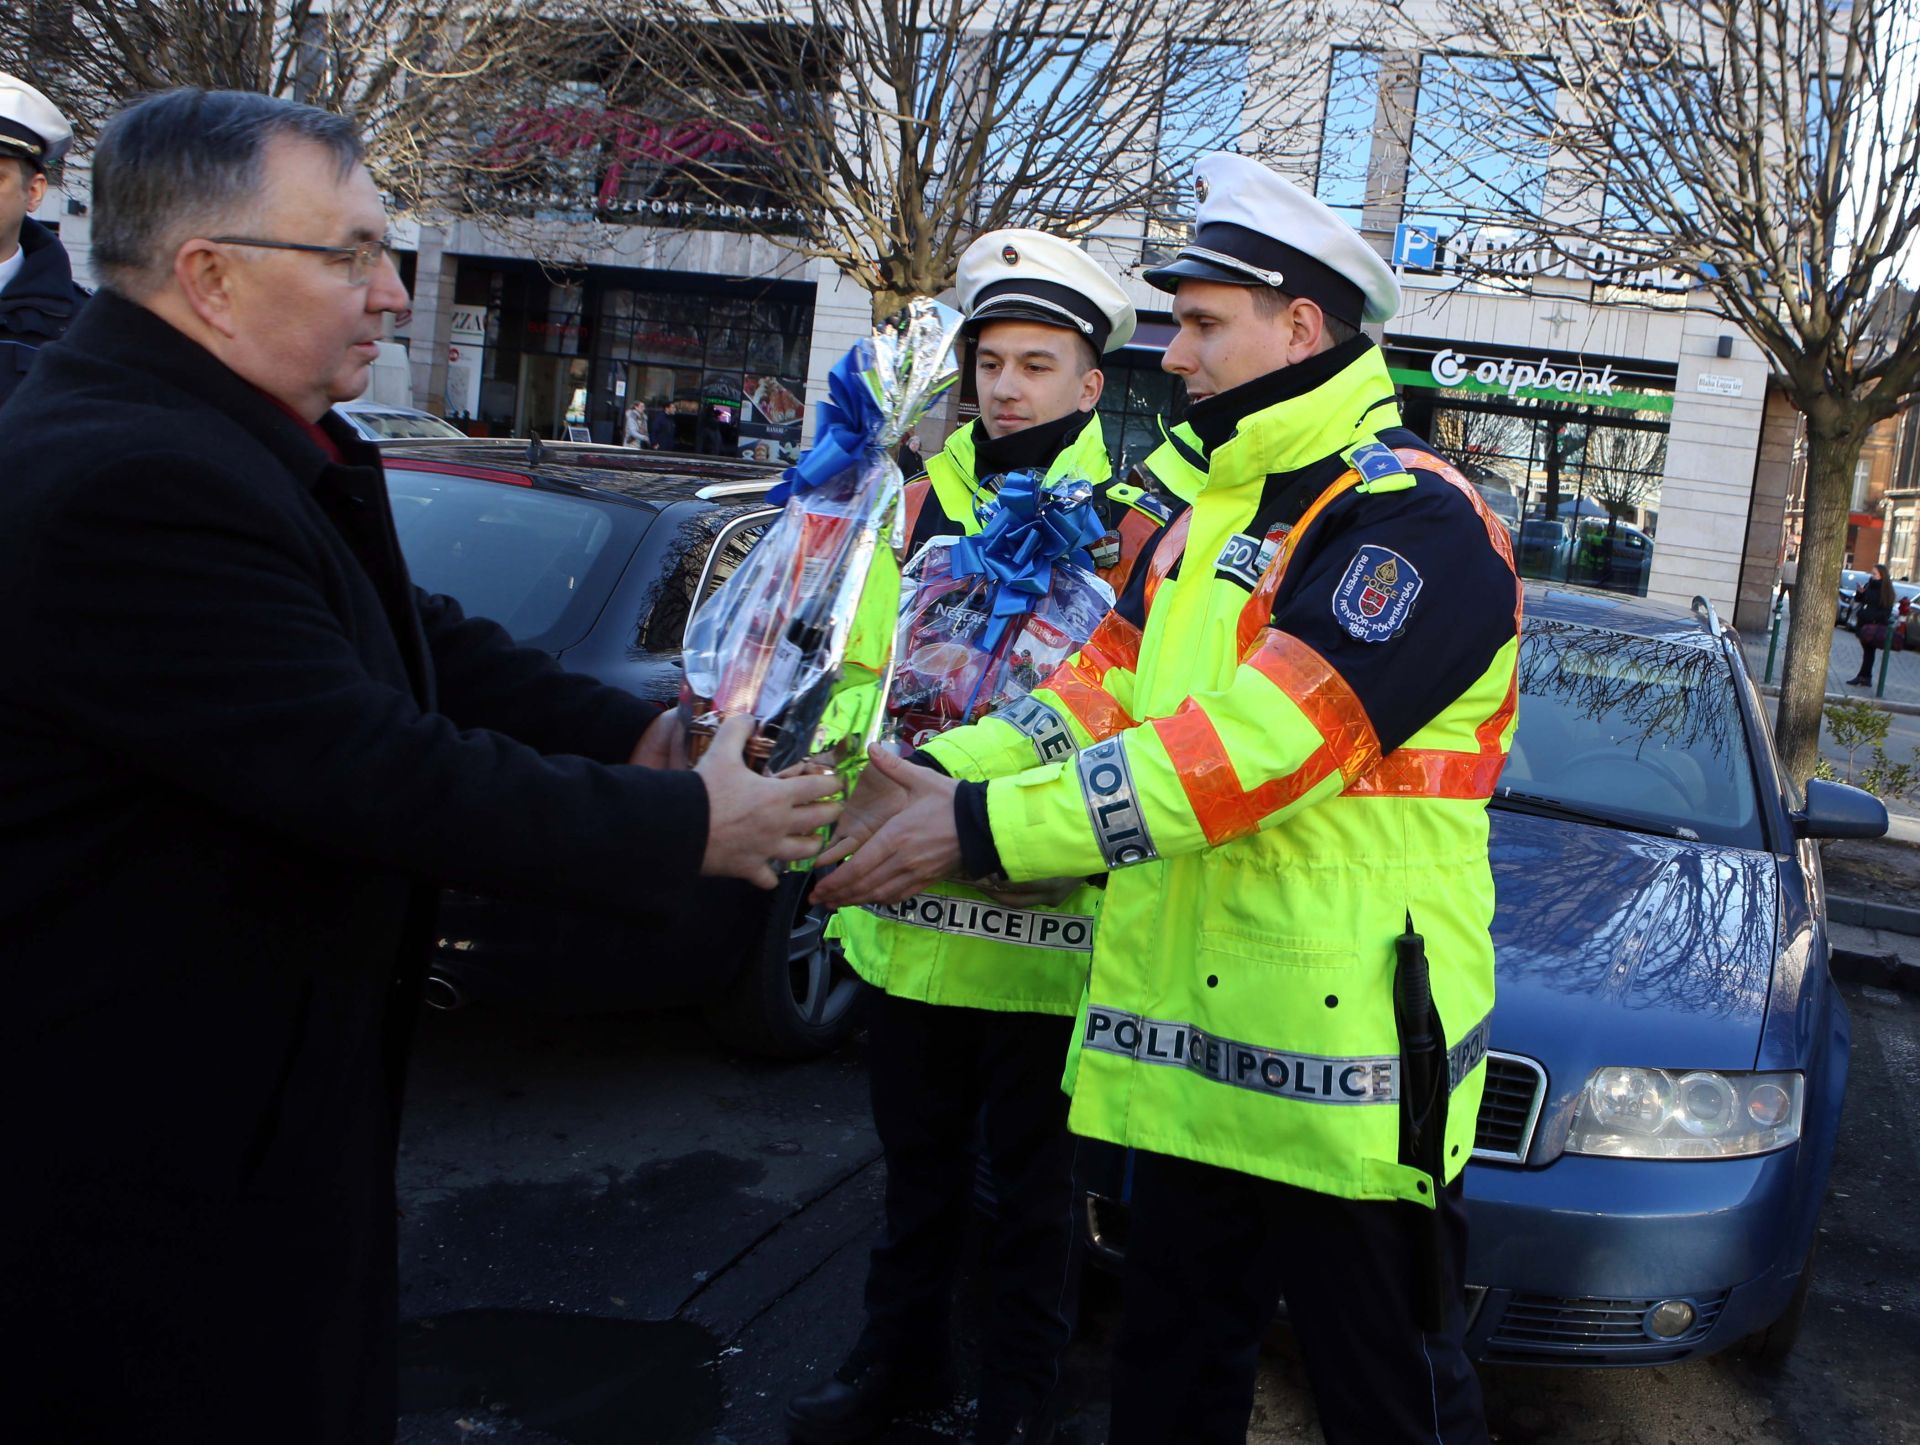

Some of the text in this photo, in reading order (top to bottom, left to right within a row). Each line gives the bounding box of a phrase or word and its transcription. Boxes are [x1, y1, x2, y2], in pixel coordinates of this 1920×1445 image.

[1402, 229, 1429, 263] P
[1475, 357, 1619, 397] otpbank
[1220, 540, 1258, 577] POL
[1343, 554, 1369, 597] BUDAPESTI
[1362, 575, 1399, 599] POLICE
[934, 602, 988, 624] NESCAF
[1348, 622, 1370, 639] 1881
[1084, 741, 1149, 863] POLIC
[899, 896, 1025, 939] POLICE
[1039, 918, 1094, 945] PO
[1086, 1012, 1219, 1074] POLICE
[1236, 1055, 1393, 1098] POLICE
